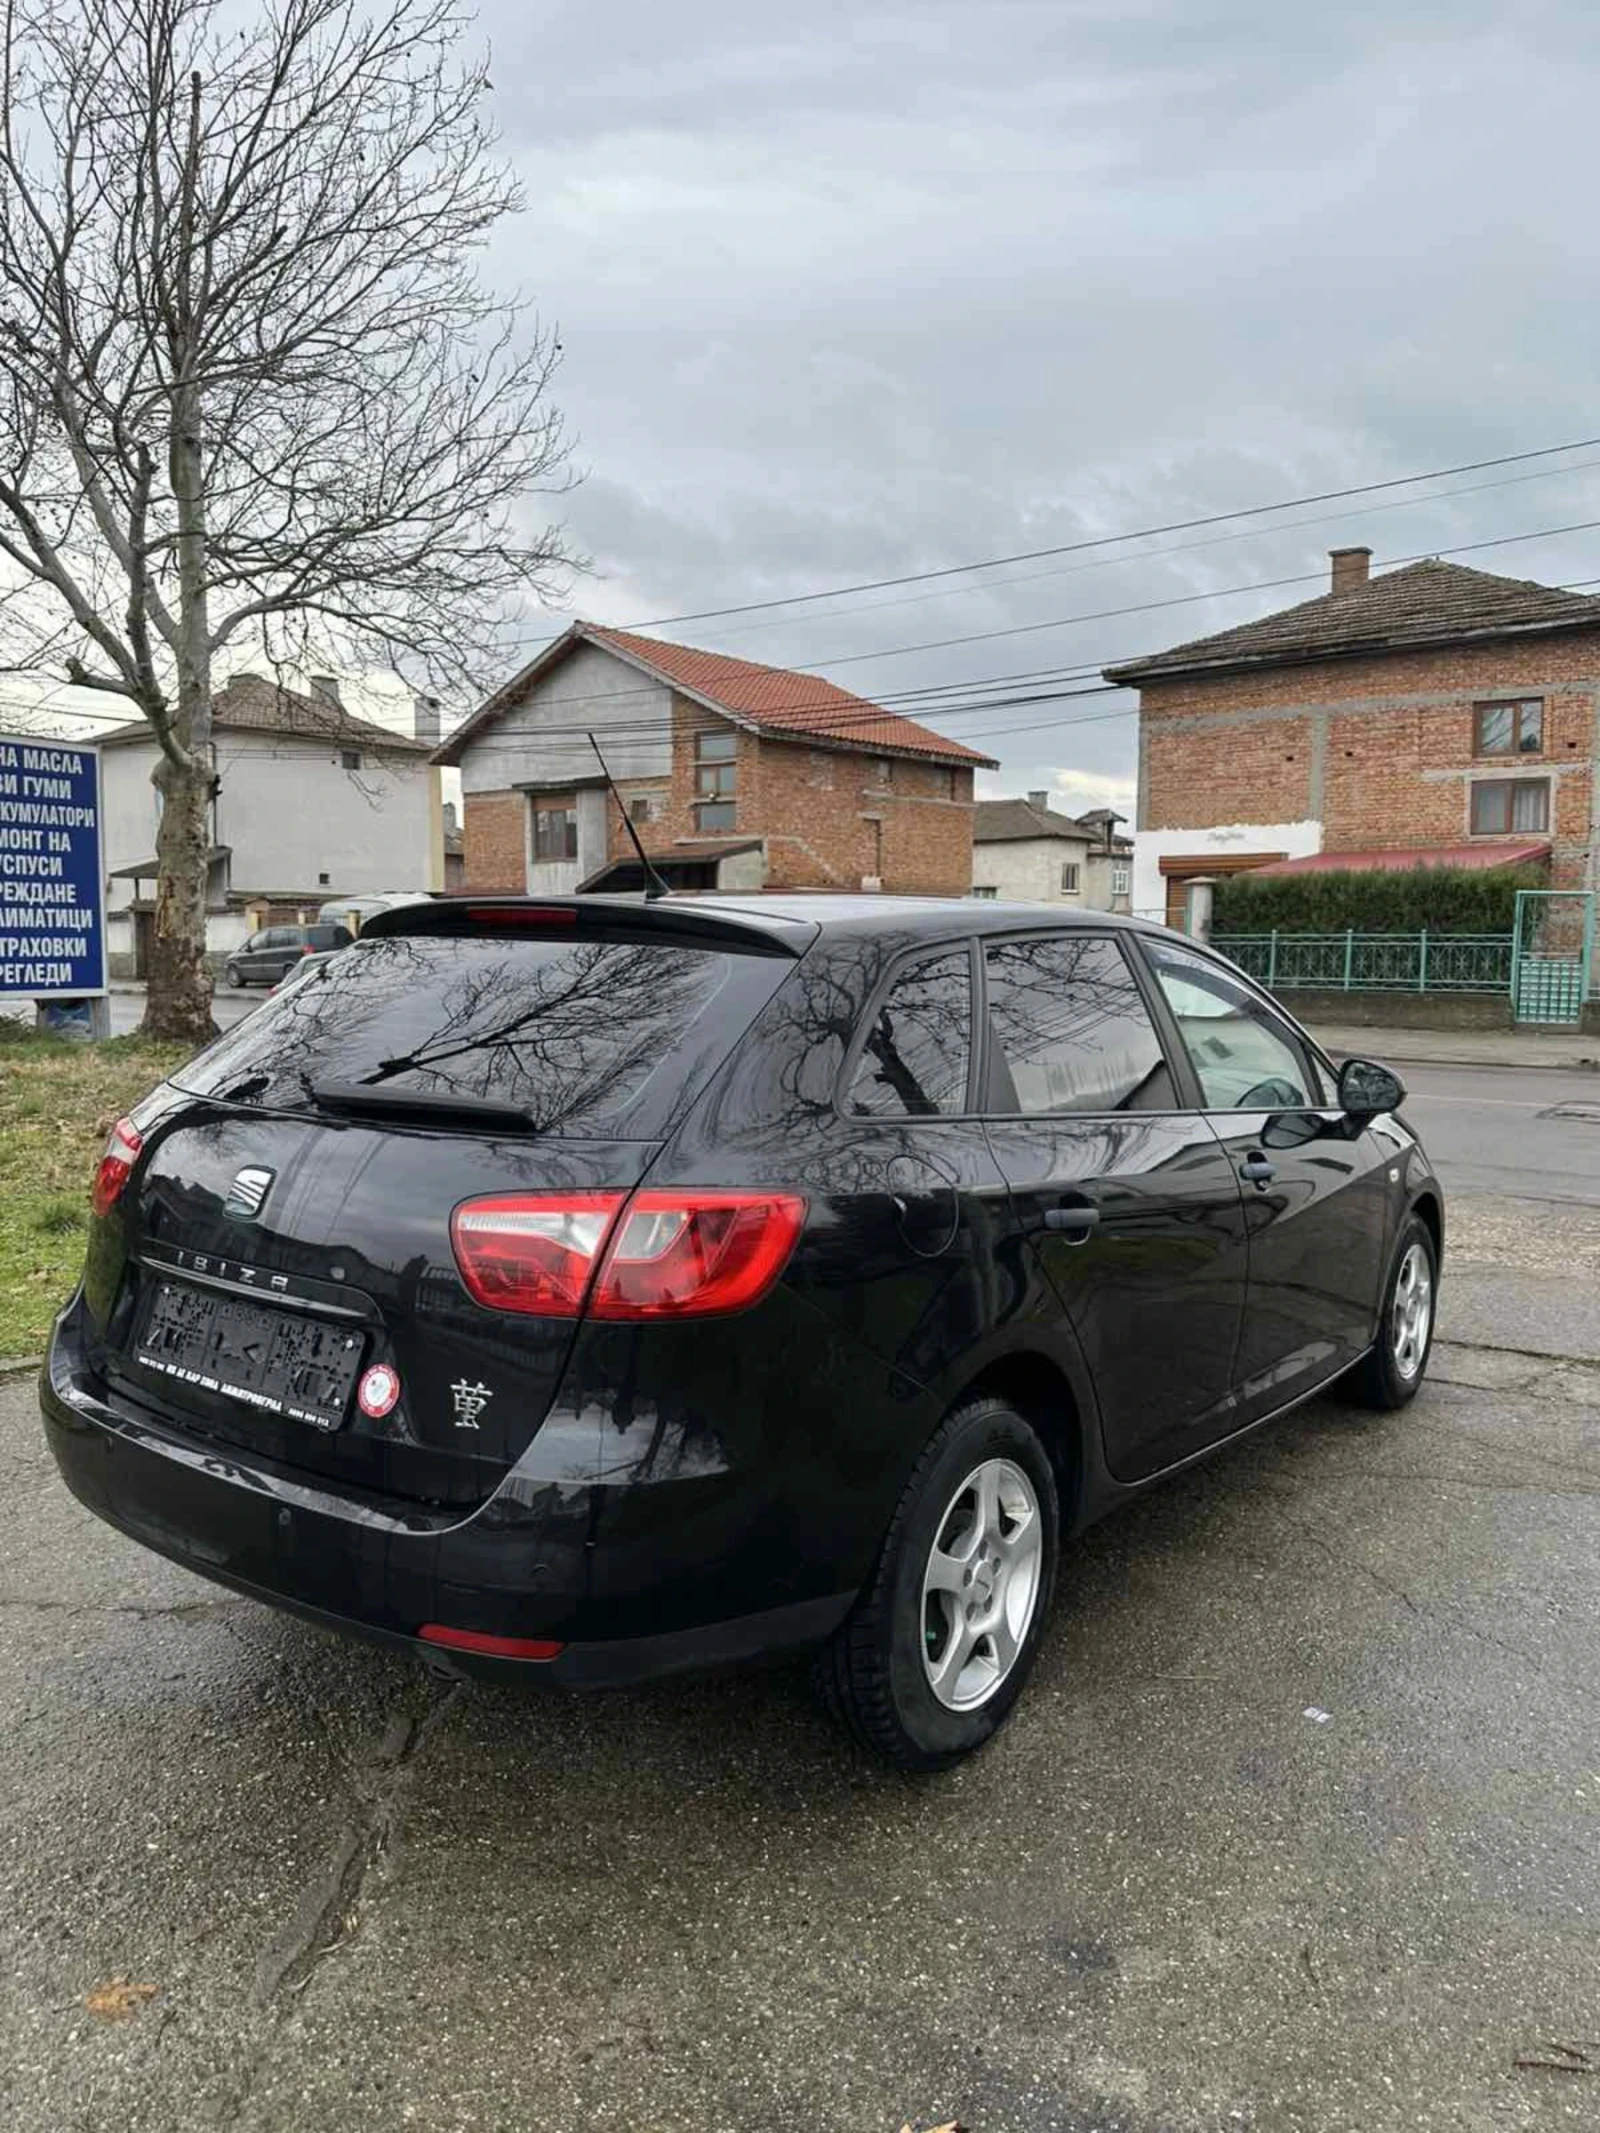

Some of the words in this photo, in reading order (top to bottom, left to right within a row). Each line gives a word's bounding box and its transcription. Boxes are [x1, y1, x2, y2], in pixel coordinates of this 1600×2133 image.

[23, 748, 83, 774] МАСЛА
[23, 776, 72, 799] ГУМИ
[48, 832, 72, 852] НА
[178, 1251, 288, 1291] IBIZA
